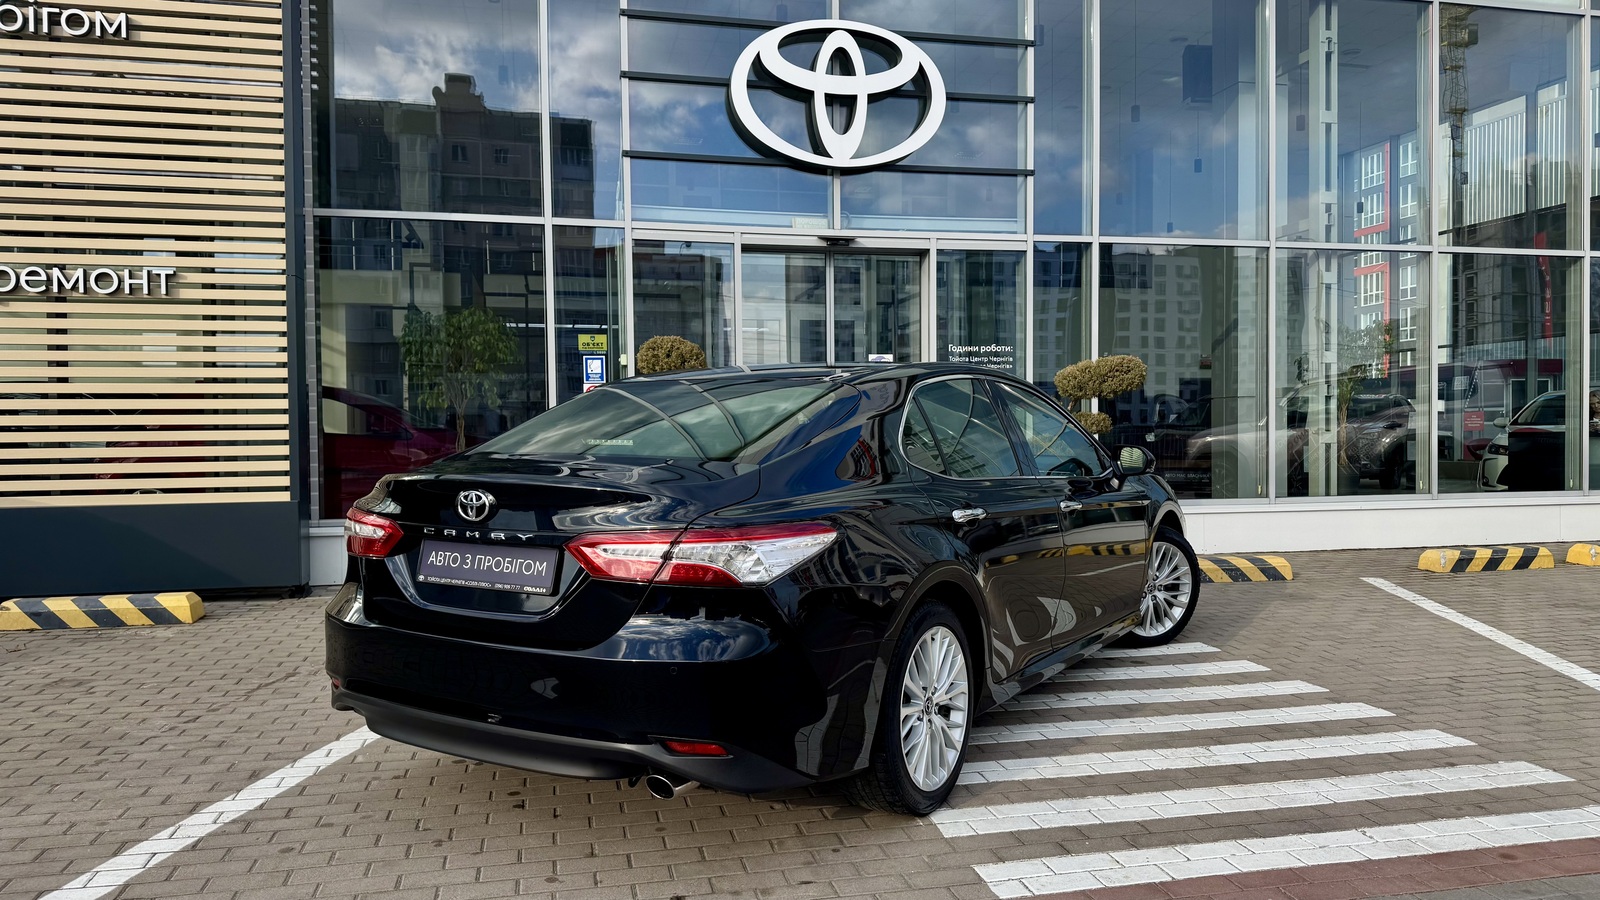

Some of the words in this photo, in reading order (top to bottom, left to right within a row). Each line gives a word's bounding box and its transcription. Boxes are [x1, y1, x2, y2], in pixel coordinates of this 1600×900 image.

[948, 344, 979, 353] Години
[981, 343, 1013, 353] роботи:
[424, 527, 533, 541] CAMRY
[428, 551, 461, 568] АВТО
[463, 554, 472, 569] З
[474, 555, 547, 577] ПРОБІГОМ
